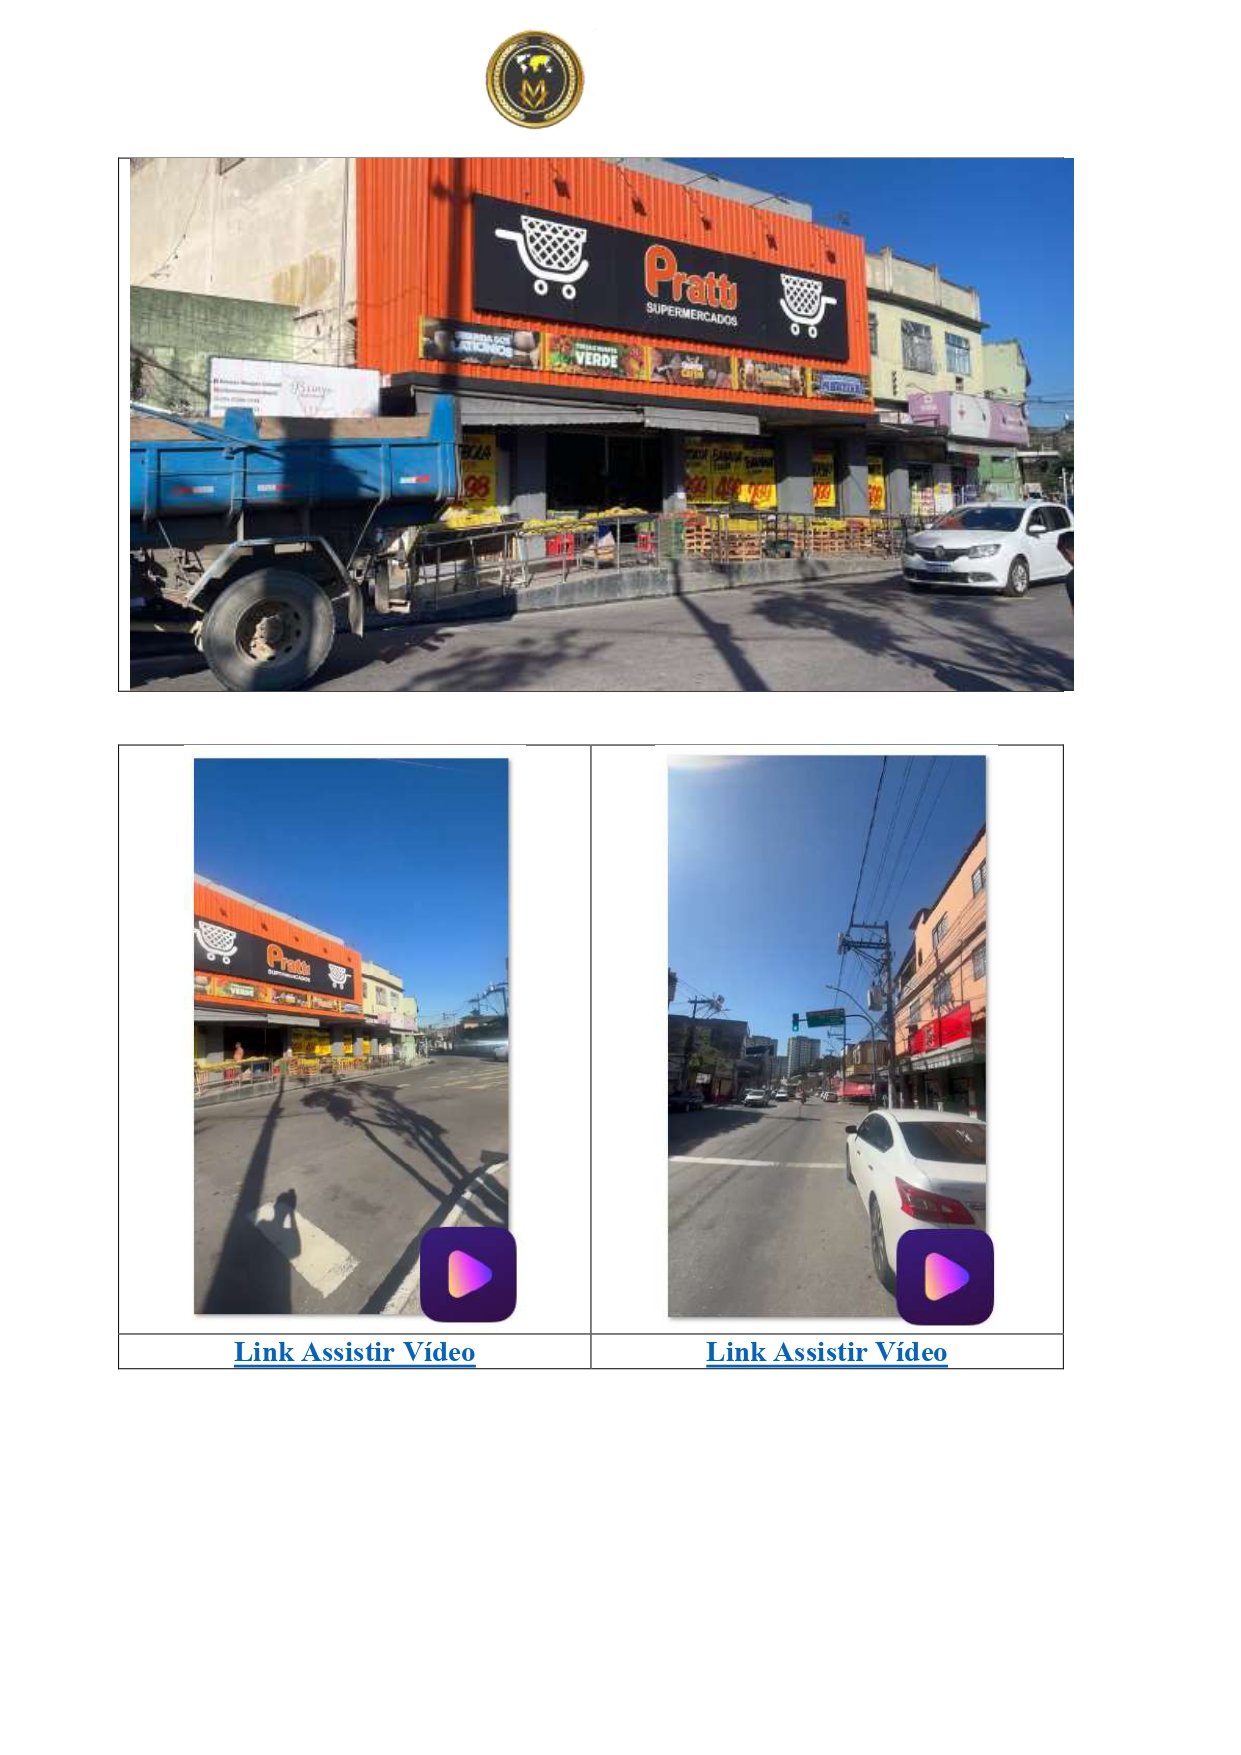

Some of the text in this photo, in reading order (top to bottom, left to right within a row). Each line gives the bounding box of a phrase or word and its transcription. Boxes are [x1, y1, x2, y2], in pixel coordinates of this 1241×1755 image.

[645, 245, 737, 309] Pratti
[646, 301, 738, 326] SUPERMERCADOS
[575, 351, 619, 369] VERDE
[234, 1341, 476, 1363] Link Assistir Vídeo
[706, 1341, 947, 1363] Link Assistir Vídeo
